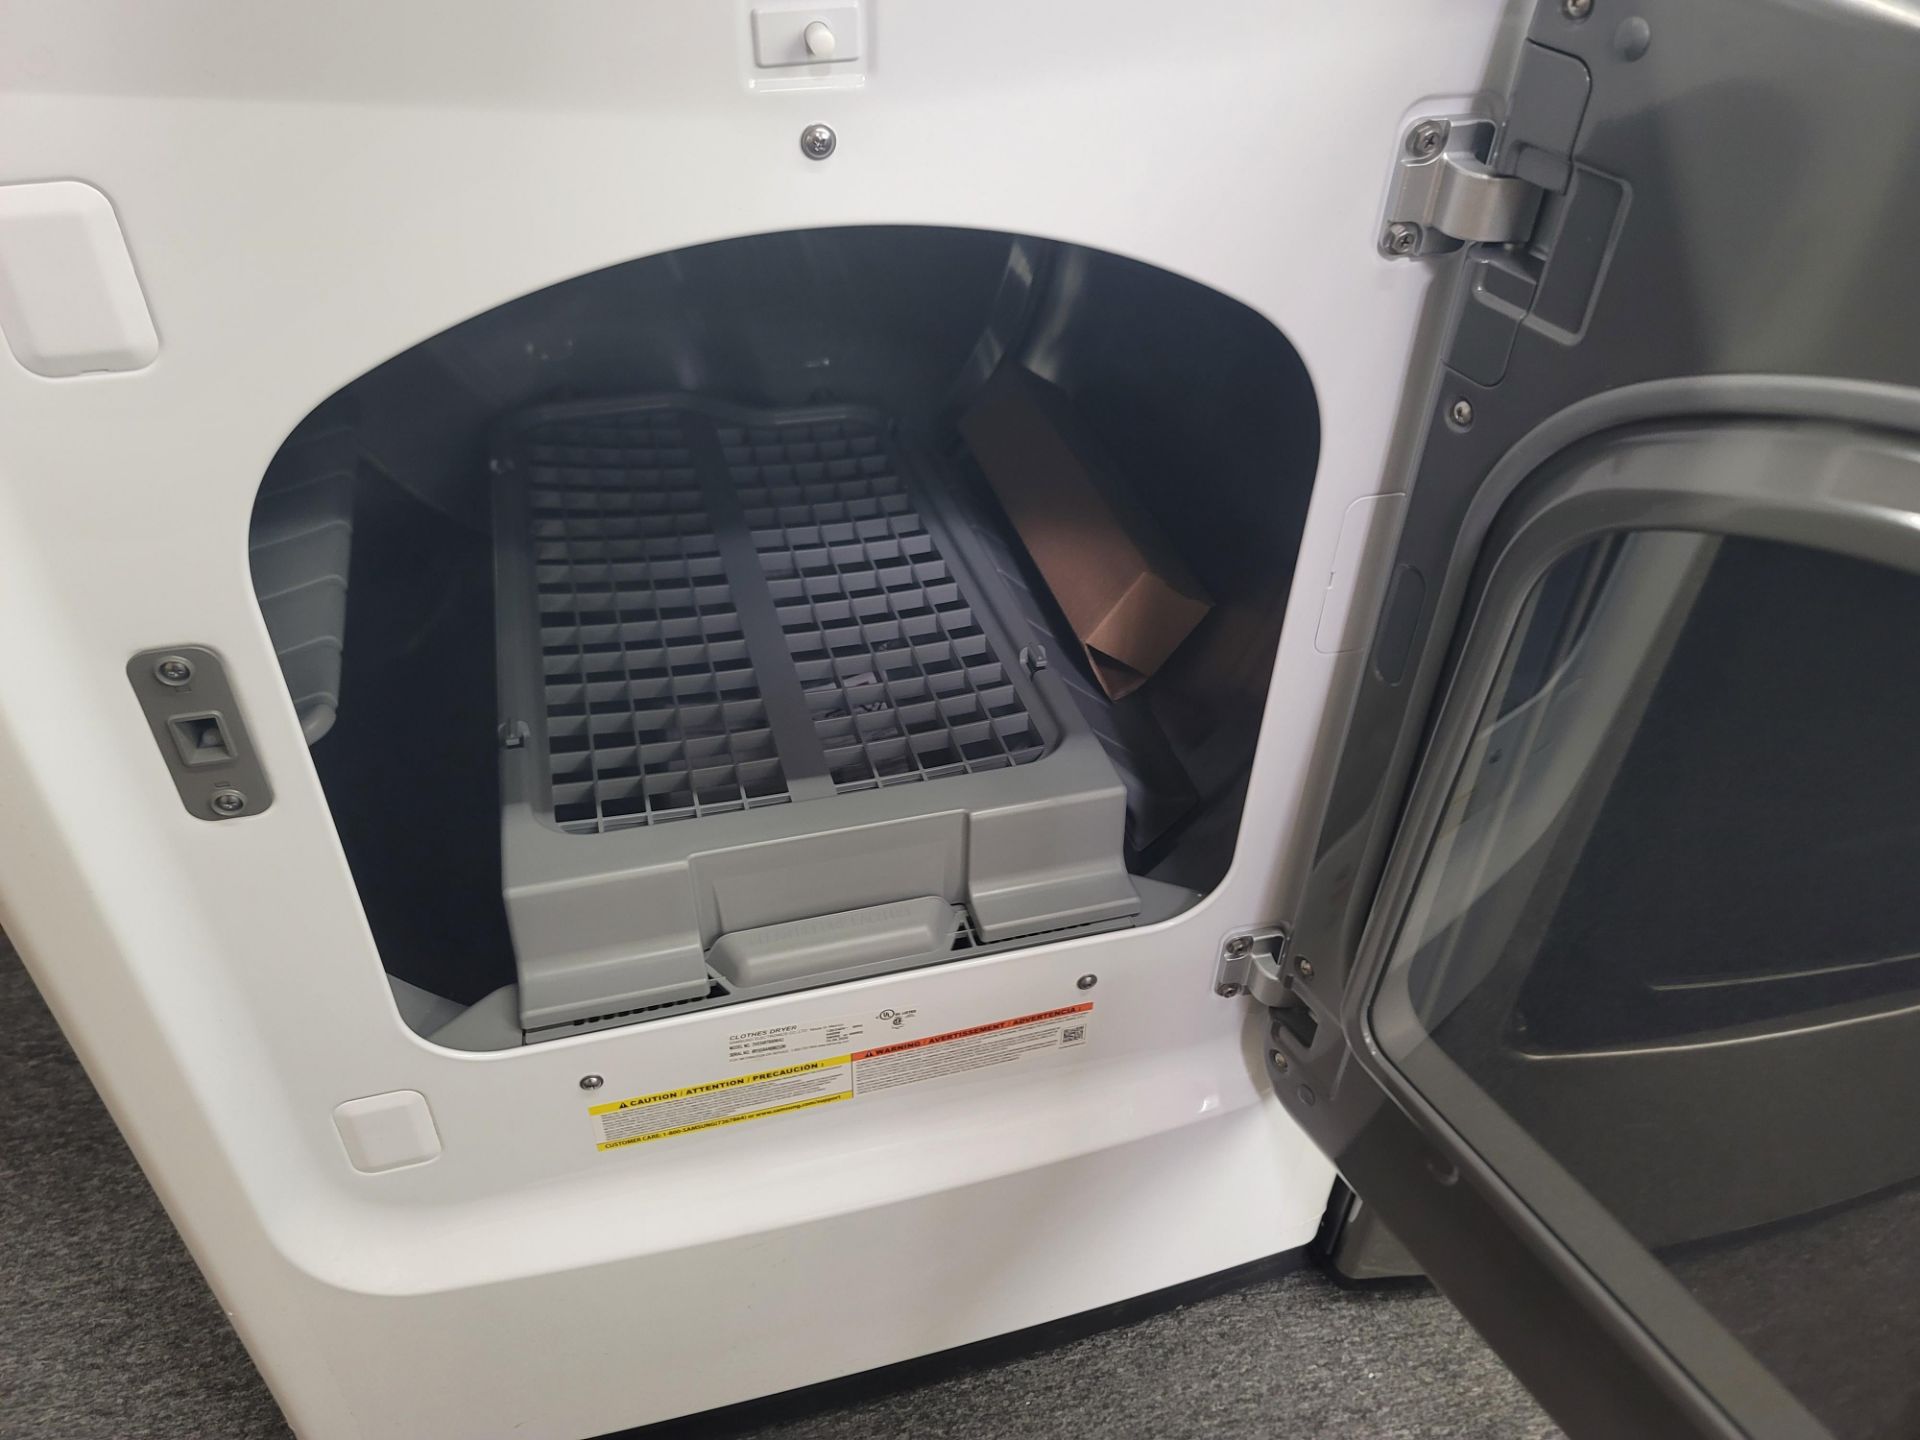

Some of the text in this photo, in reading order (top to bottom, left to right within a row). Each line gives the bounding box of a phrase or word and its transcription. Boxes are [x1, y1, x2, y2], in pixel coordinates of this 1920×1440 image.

[729, 1030, 768, 1041] CLOTHES
[769, 1024, 798, 1035] DRYER
[876, 1041, 921, 1055] WARNING
[928, 1022, 1005, 1044] AVERTISSEMENT
[1014, 1007, 1076, 1026] ADVERTENCIA
[630, 1092, 677, 1106] CAUTION
[686, 1079, 744, 1096] ATTENTION
[605, 1137, 641, 1149] CUSTOMER
